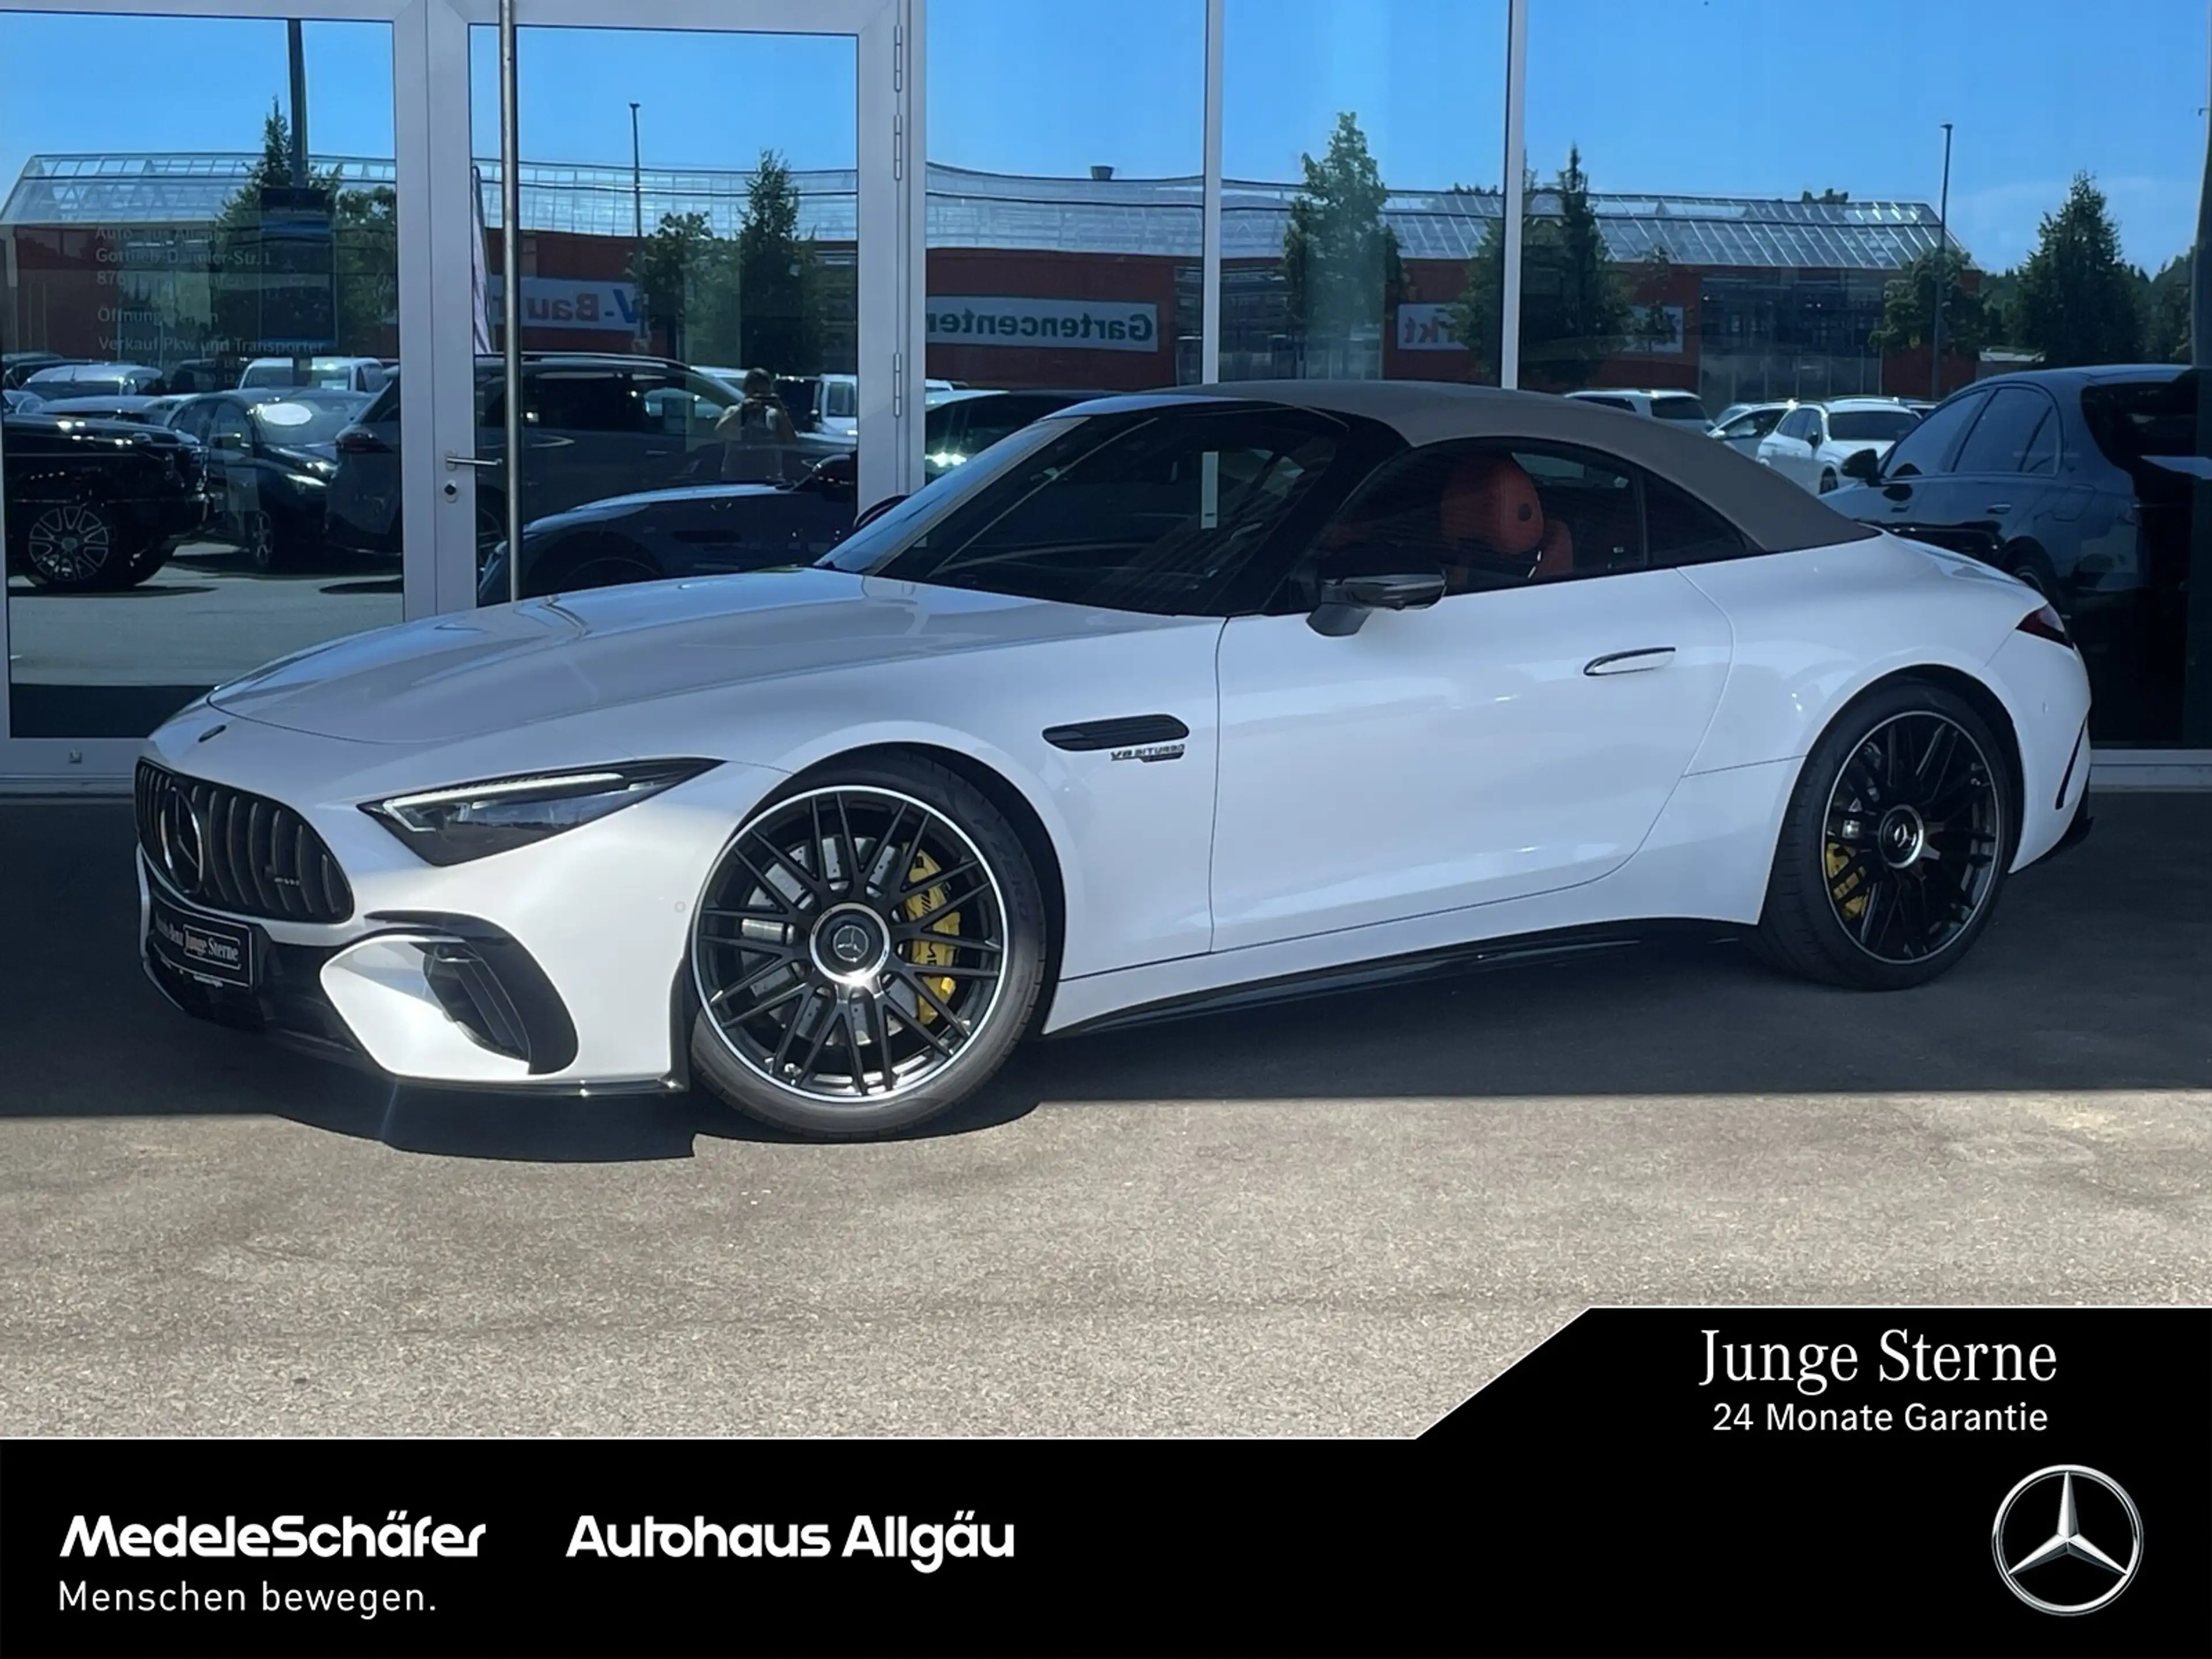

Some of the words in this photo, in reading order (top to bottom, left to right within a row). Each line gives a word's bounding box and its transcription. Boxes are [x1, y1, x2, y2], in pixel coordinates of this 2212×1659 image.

[99, 336, 158, 350] Verkauf
[164, 336, 197, 350] Pkw
[234, 337, 324, 354] Transporter
[207, 937, 239, 962] Sterne
